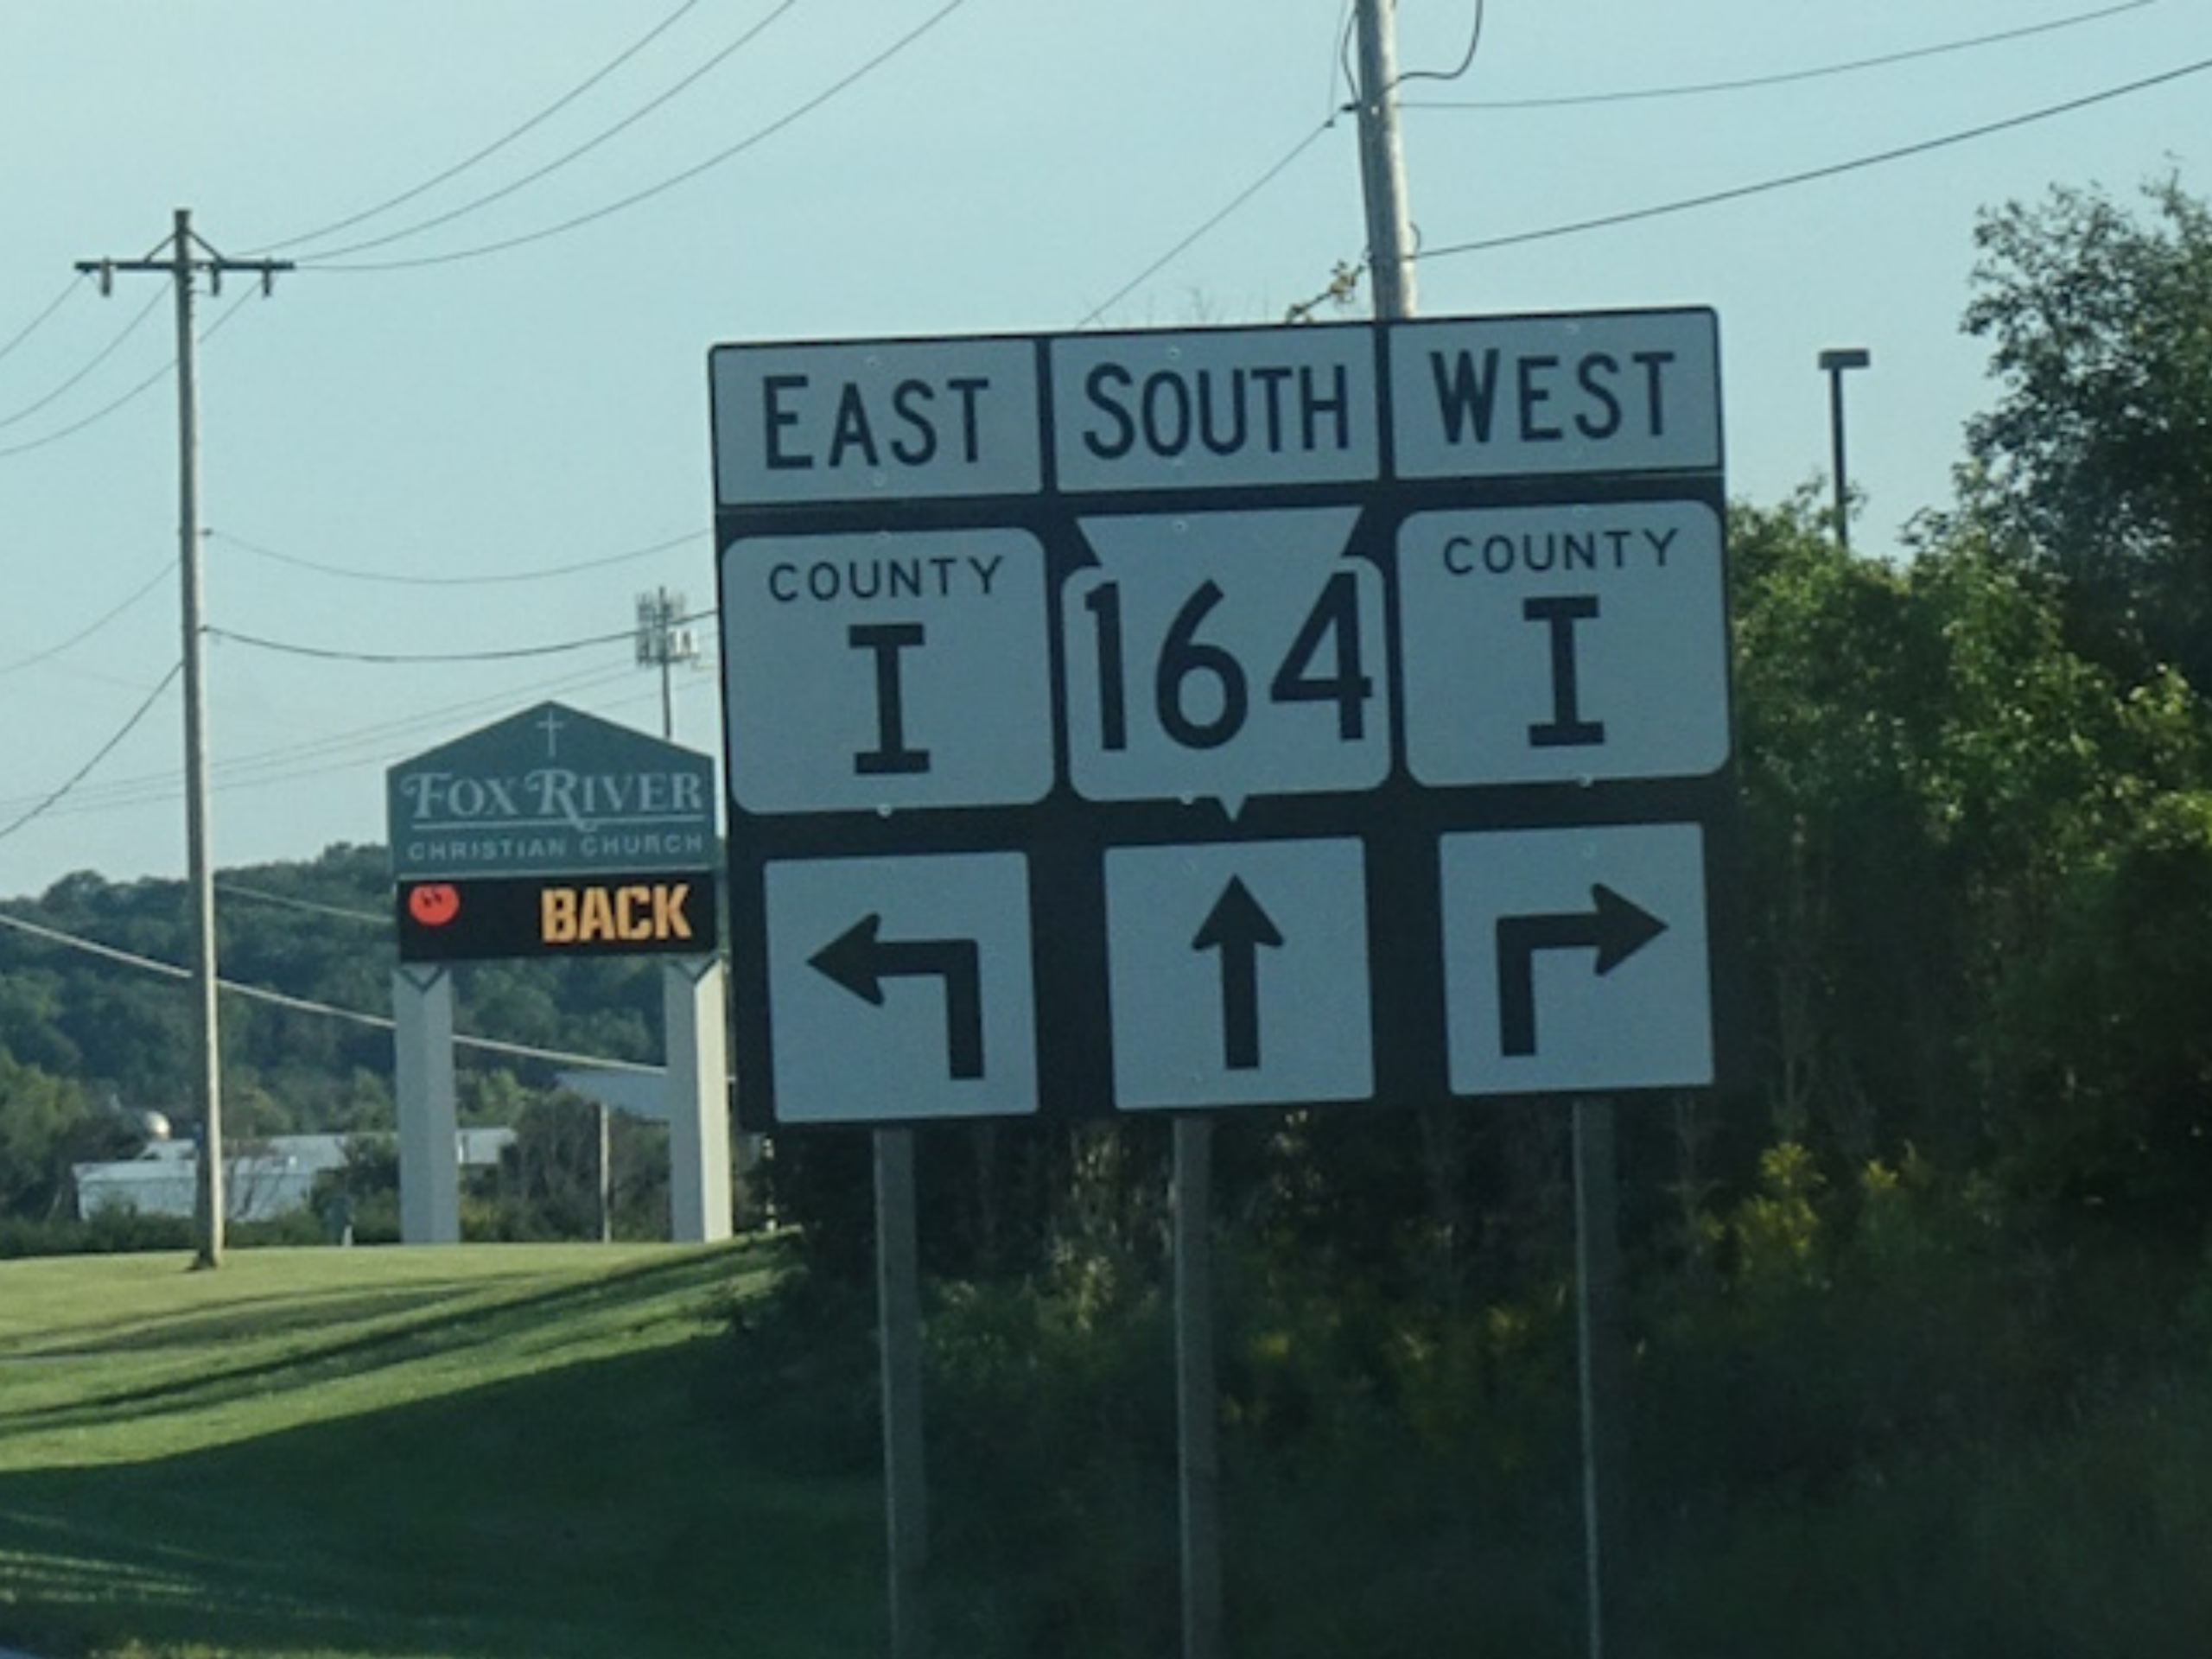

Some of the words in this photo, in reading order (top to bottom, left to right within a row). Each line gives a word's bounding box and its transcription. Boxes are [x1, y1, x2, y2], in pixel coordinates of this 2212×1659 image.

[762, 374, 991, 469] EAST
[1083, 363, 1350, 461] SOUTH
[1430, 348, 1677, 445] WEST
[767, 555, 1004, 602] COUNTY
[1443, 528, 1680, 575] COUNTY
[848, 623, 931, 776] I
[1084, 570, 1374, 751] 164
[1522, 595, 1606, 747] I
[400, 772, 518, 819] FOX
[525, 769, 703, 832] RIVER
[408, 836, 567, 861] CHRISTIAN
[580, 832, 704, 856] CHURCH
[541, 883, 692, 944] BACK
